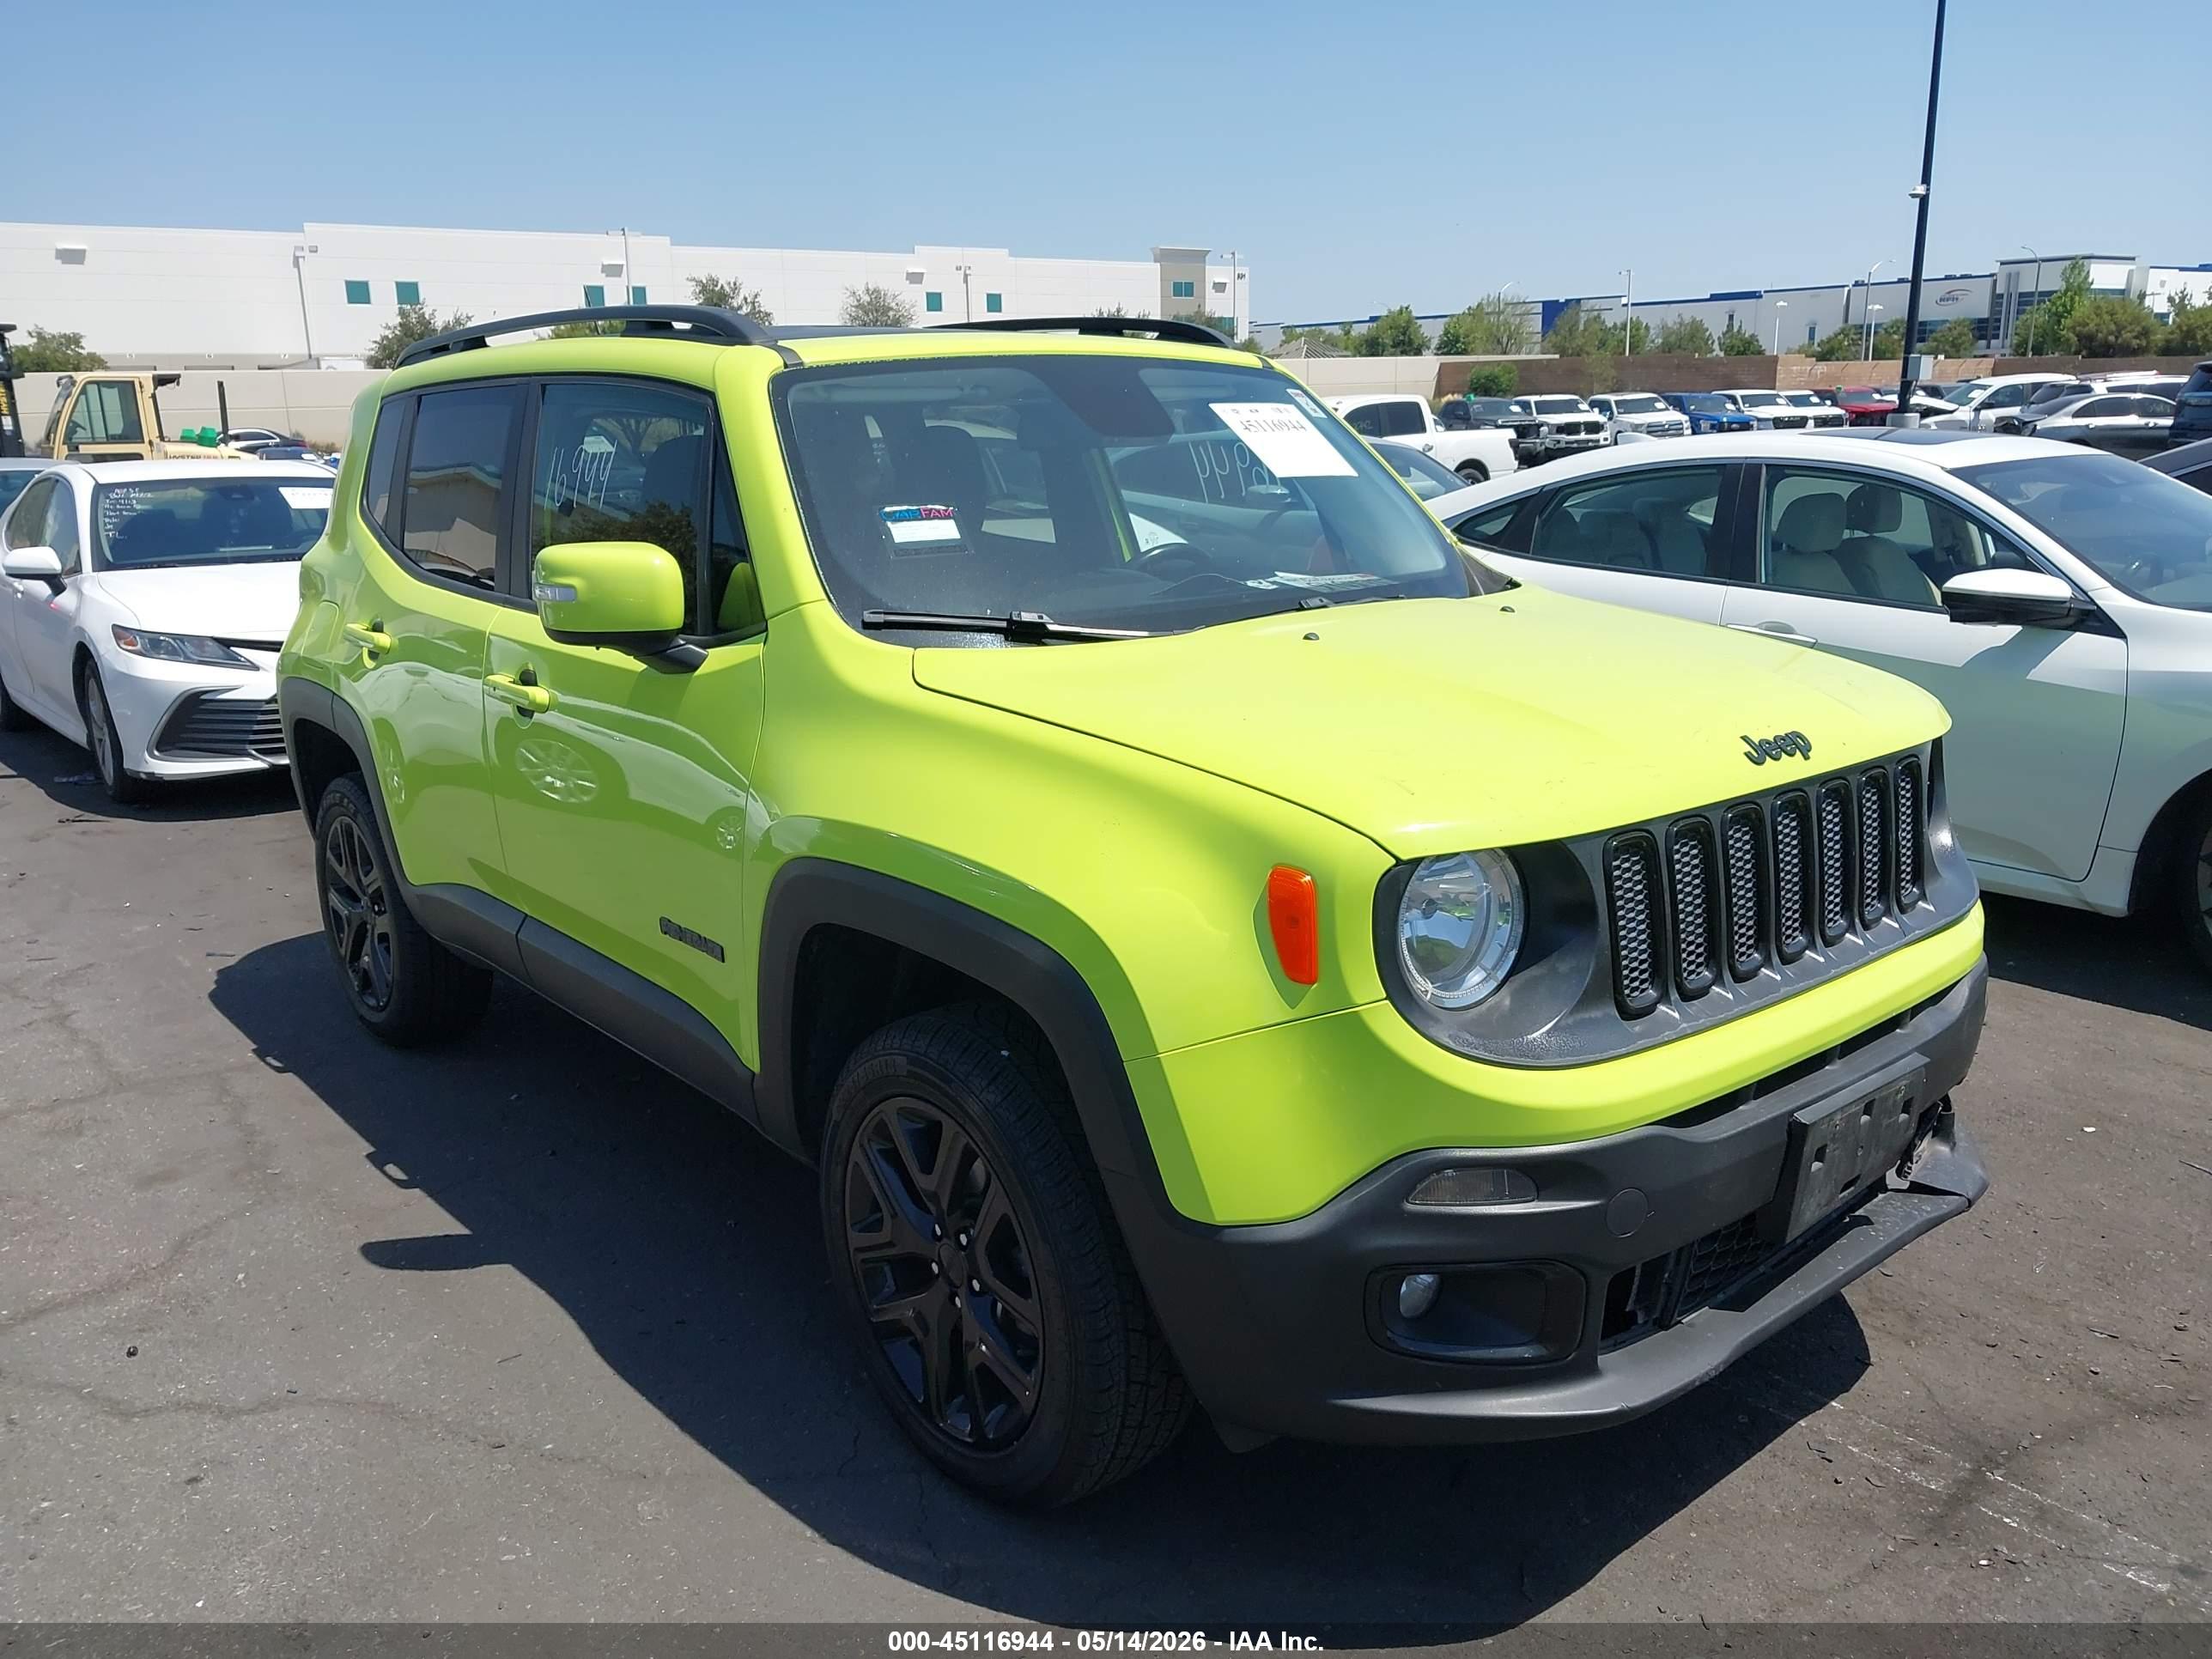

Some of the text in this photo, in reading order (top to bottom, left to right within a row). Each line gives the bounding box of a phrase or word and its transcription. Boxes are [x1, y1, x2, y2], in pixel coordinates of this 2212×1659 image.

[1240, 419, 1307, 433] 45116944
[544, 439, 618, 510] 16944
[1740, 731, 1812, 766] Jeep
